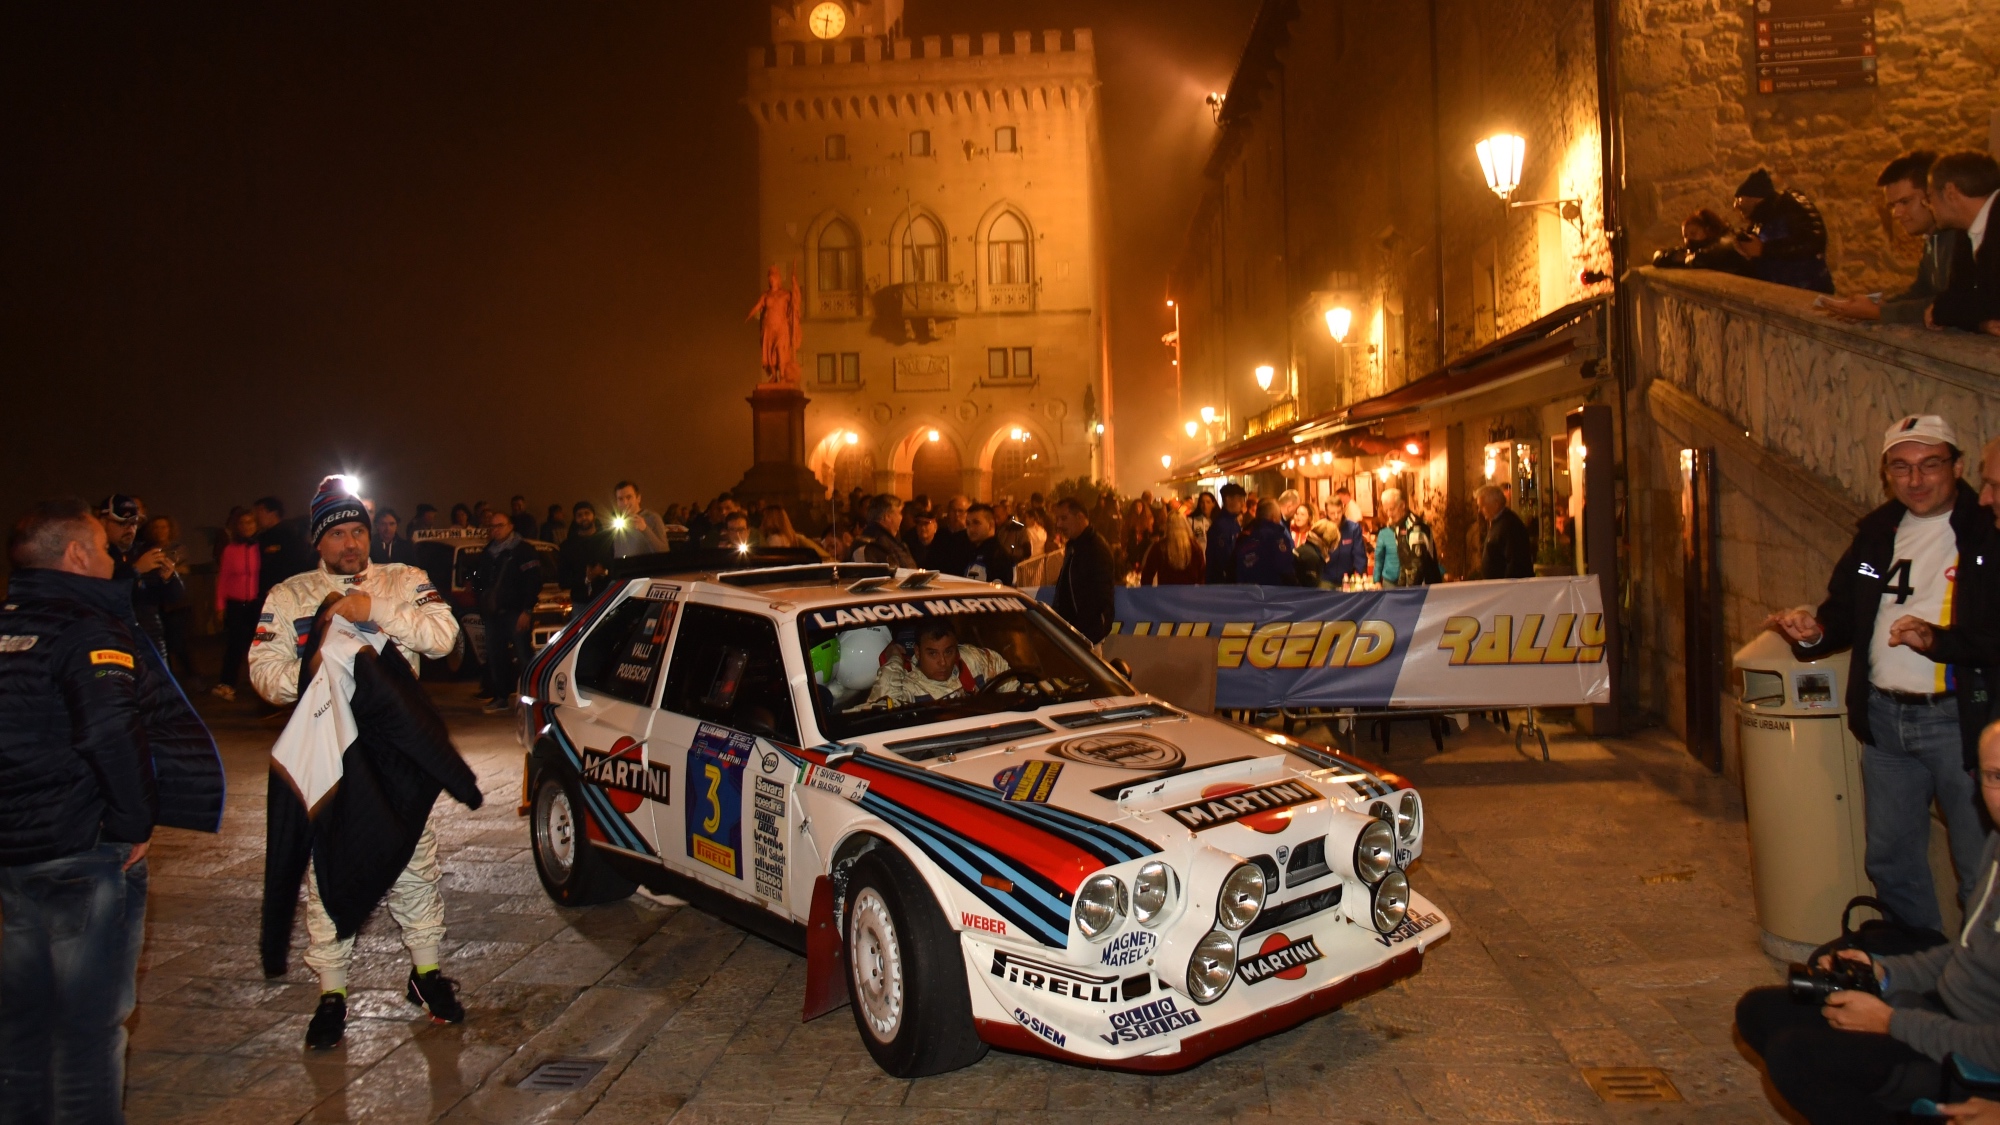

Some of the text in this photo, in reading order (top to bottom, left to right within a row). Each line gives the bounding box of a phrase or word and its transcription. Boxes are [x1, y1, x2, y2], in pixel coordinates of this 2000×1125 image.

[646, 583, 681, 600] PIRELLI
[1882, 559, 1915, 604] 4
[813, 597, 1028, 629] LANCIA MARTINI
[631, 642, 653, 658] VALLI
[1438, 613, 1607, 666] RALLY
[616, 661, 652, 682] PODESCHI
[1760, 720, 1790, 731] URBANA
[728, 740, 750, 751] STARS
[718, 751, 742, 766] MARTINI
[584, 752, 668, 798] MARTINI
[820, 768, 846, 784] SIVIERO
[703, 763, 722, 834] 3
[756, 776, 784, 798] Savara
[817, 780, 843, 795] BIASION
[1176, 782, 1315, 826] MARTINI
[755, 810, 776, 825] OLIO
[759, 821, 780, 837] FIAT
[754, 828, 784, 851] brembo
[696, 839, 732, 869] PIRELLI
[754, 841, 787, 866] TRW Sabelt
[754, 857, 784, 878] olivetti
[756, 869, 783, 889] FERODO
[755, 881, 783, 903] BILSTEIN
[961, 912, 1007, 935] WEBER
[1102, 930, 1157, 961] MAGNETI
[1240, 941, 1319, 981] MARTINI
[991, 948, 1120, 1003] PIRELLI
[1110, 997, 1176, 1030] OLIO
[1139, 1008, 1201, 1038] FIAT
[1030, 1017, 1067, 1048] SIEM
